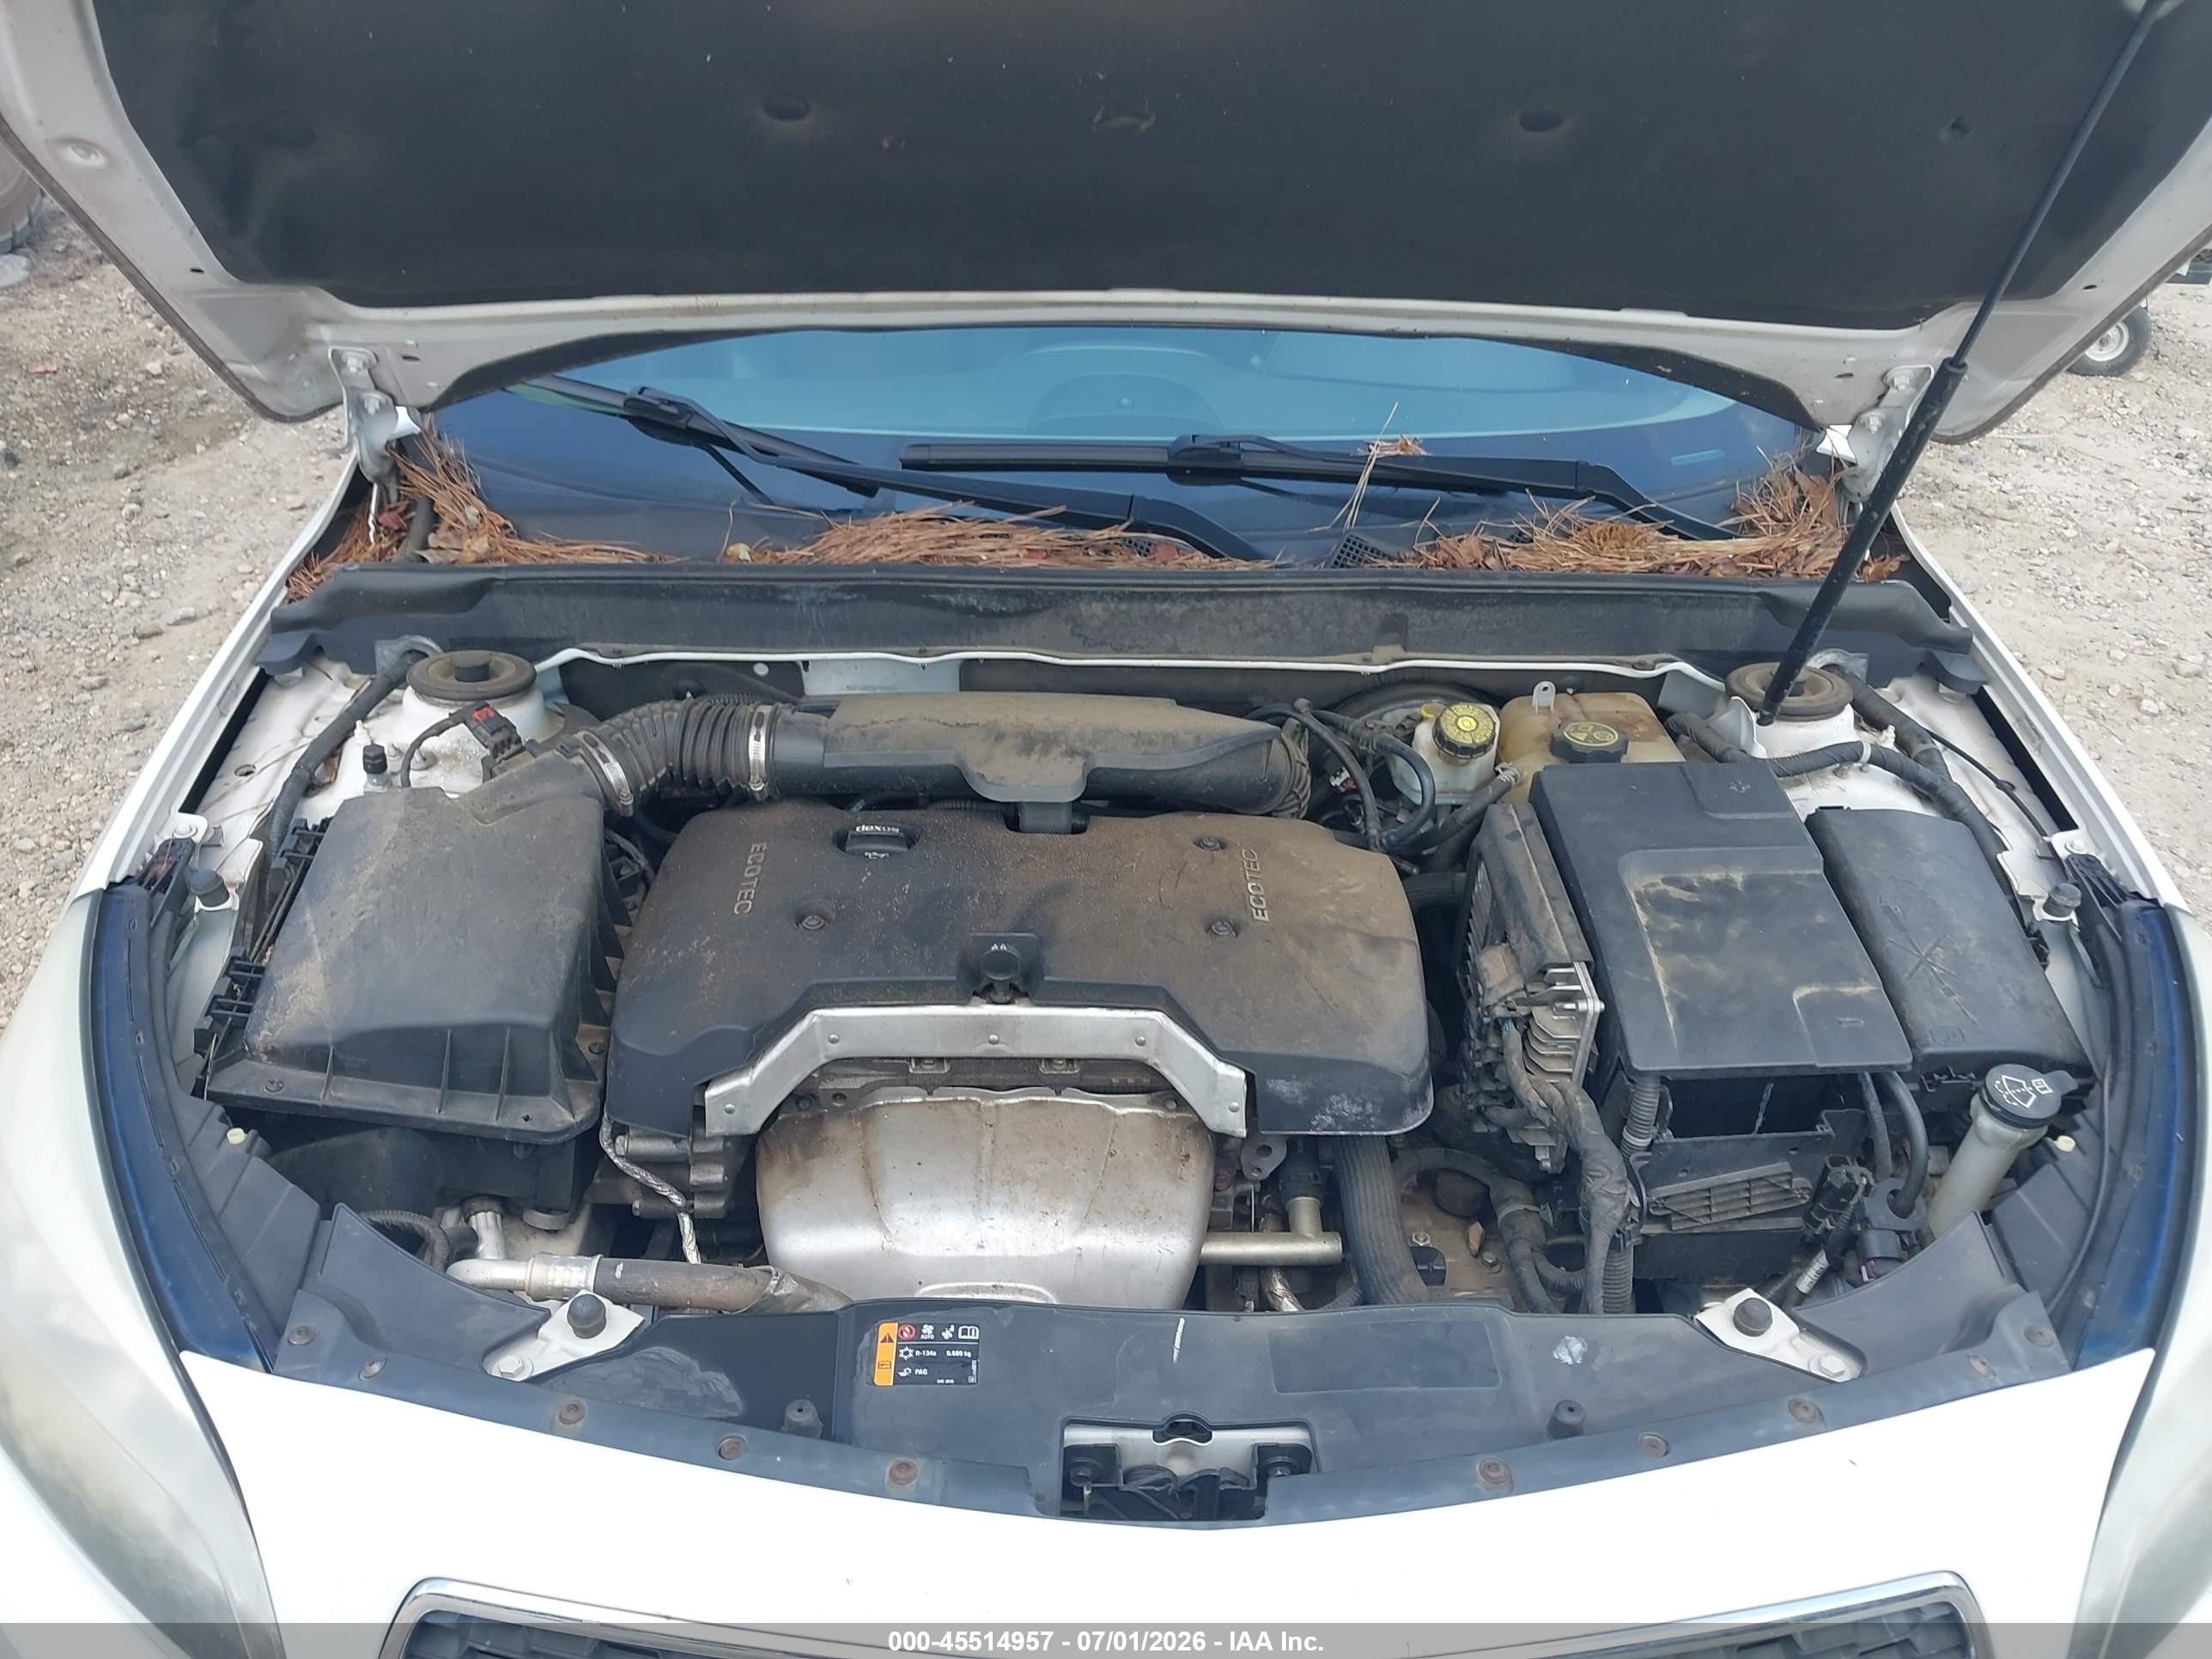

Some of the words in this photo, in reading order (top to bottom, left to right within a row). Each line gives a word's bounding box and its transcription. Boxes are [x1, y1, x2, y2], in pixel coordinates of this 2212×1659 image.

[855, 824, 900, 833] dexos
[734, 842, 769, 915] ECOTEC
[1242, 848, 1270, 922] ECOTEC
